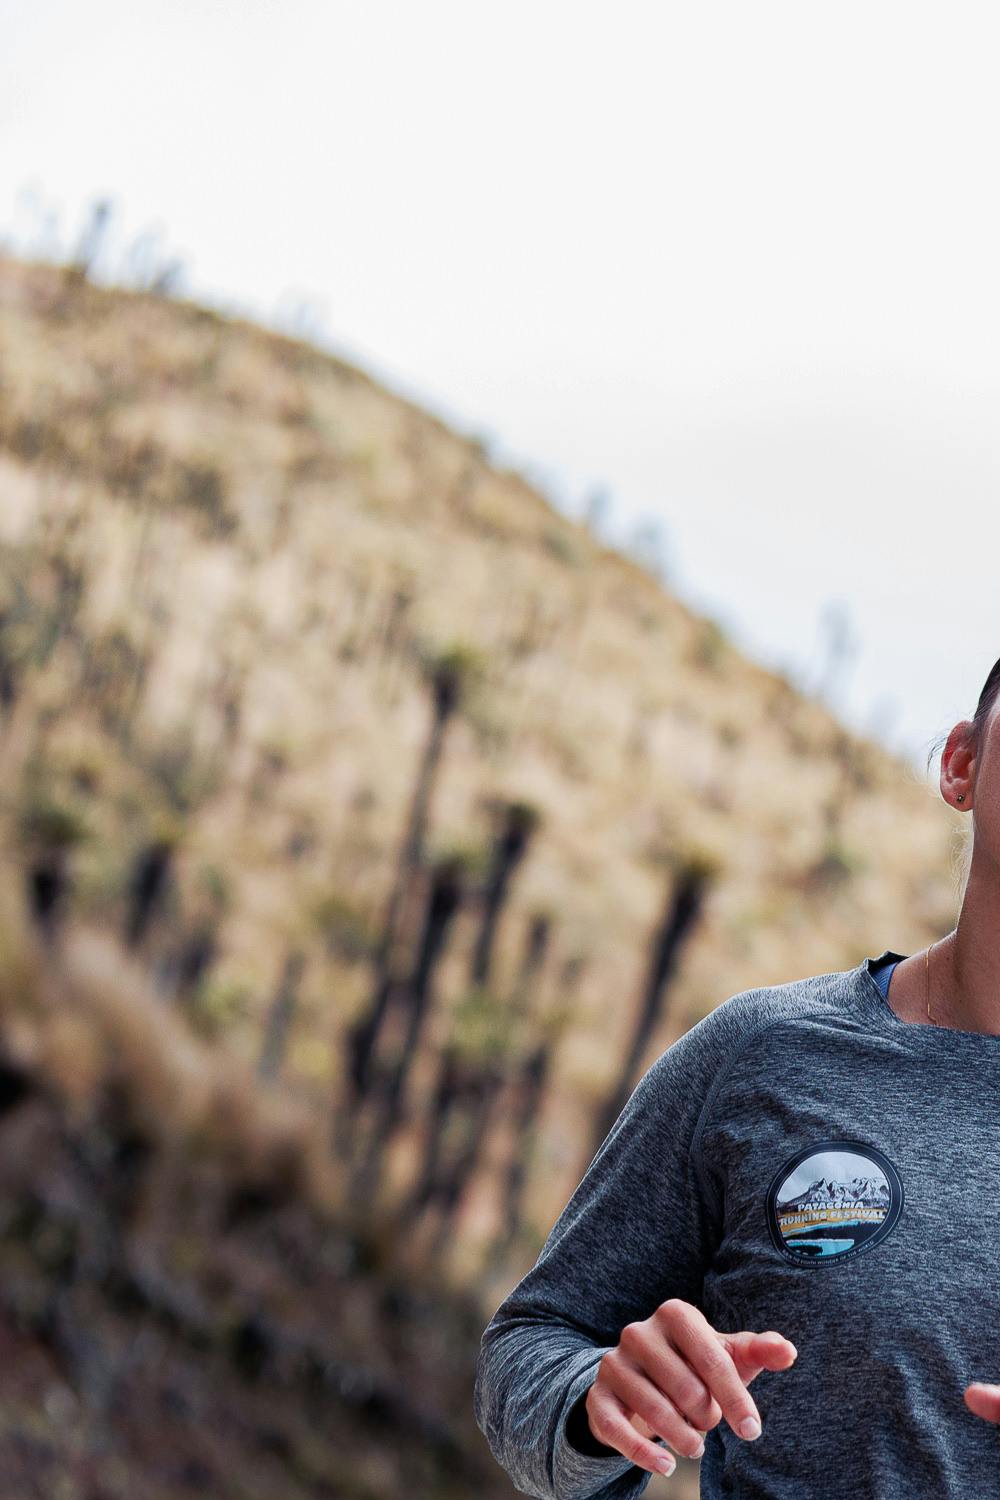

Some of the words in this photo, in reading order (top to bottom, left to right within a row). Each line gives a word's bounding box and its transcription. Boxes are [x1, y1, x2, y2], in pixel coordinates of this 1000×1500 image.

[797, 1201, 865, 1212] PATAGONIA
[780, 1211, 827, 1226] RUNNING
[830, 1209, 886, 1220] FESTIVAL
